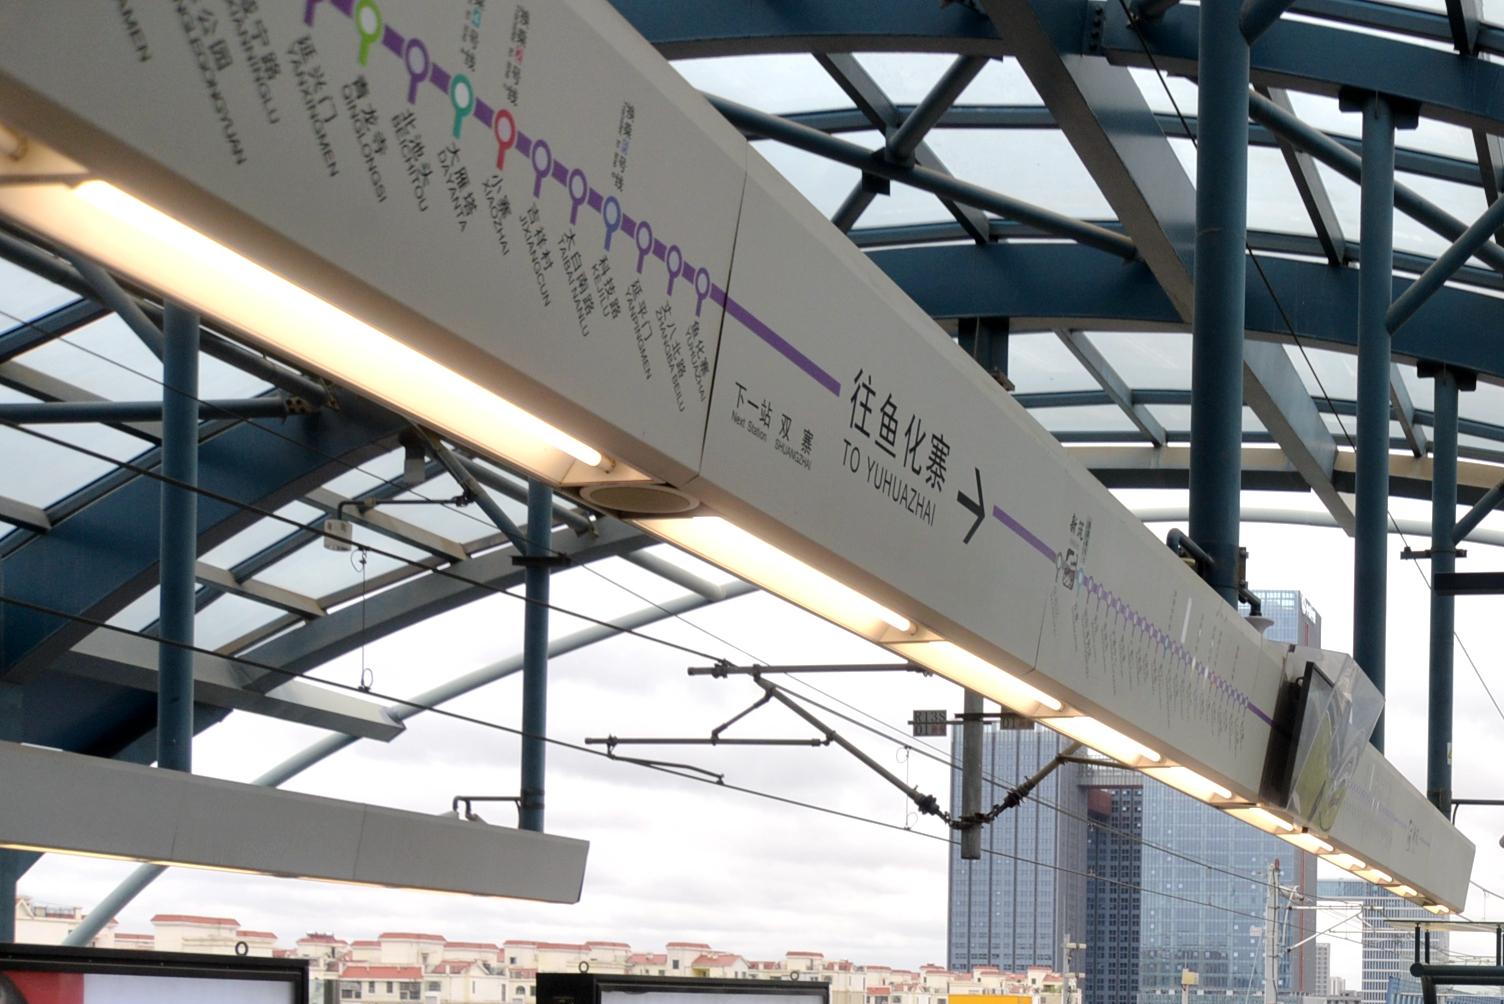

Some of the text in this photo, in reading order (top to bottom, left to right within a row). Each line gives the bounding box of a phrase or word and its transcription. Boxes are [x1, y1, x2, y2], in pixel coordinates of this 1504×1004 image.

[341, 83, 388, 203] QINGLONGSI
[391, 113, 428, 212] BEICHITOU
[437, 150, 469, 233] DAYANTA
[482, 177, 511, 257] XIAOZHAI
[519, 214, 552, 308] JIXIANGCUN
[731, 409, 746, 429] Next
[747, 420, 767, 443] Station
[735, 381, 773, 429] 下一站
[849, 368, 951, 493] 往鱼化寨
[842, 438, 937, 527] TO YUHUAZHAI
